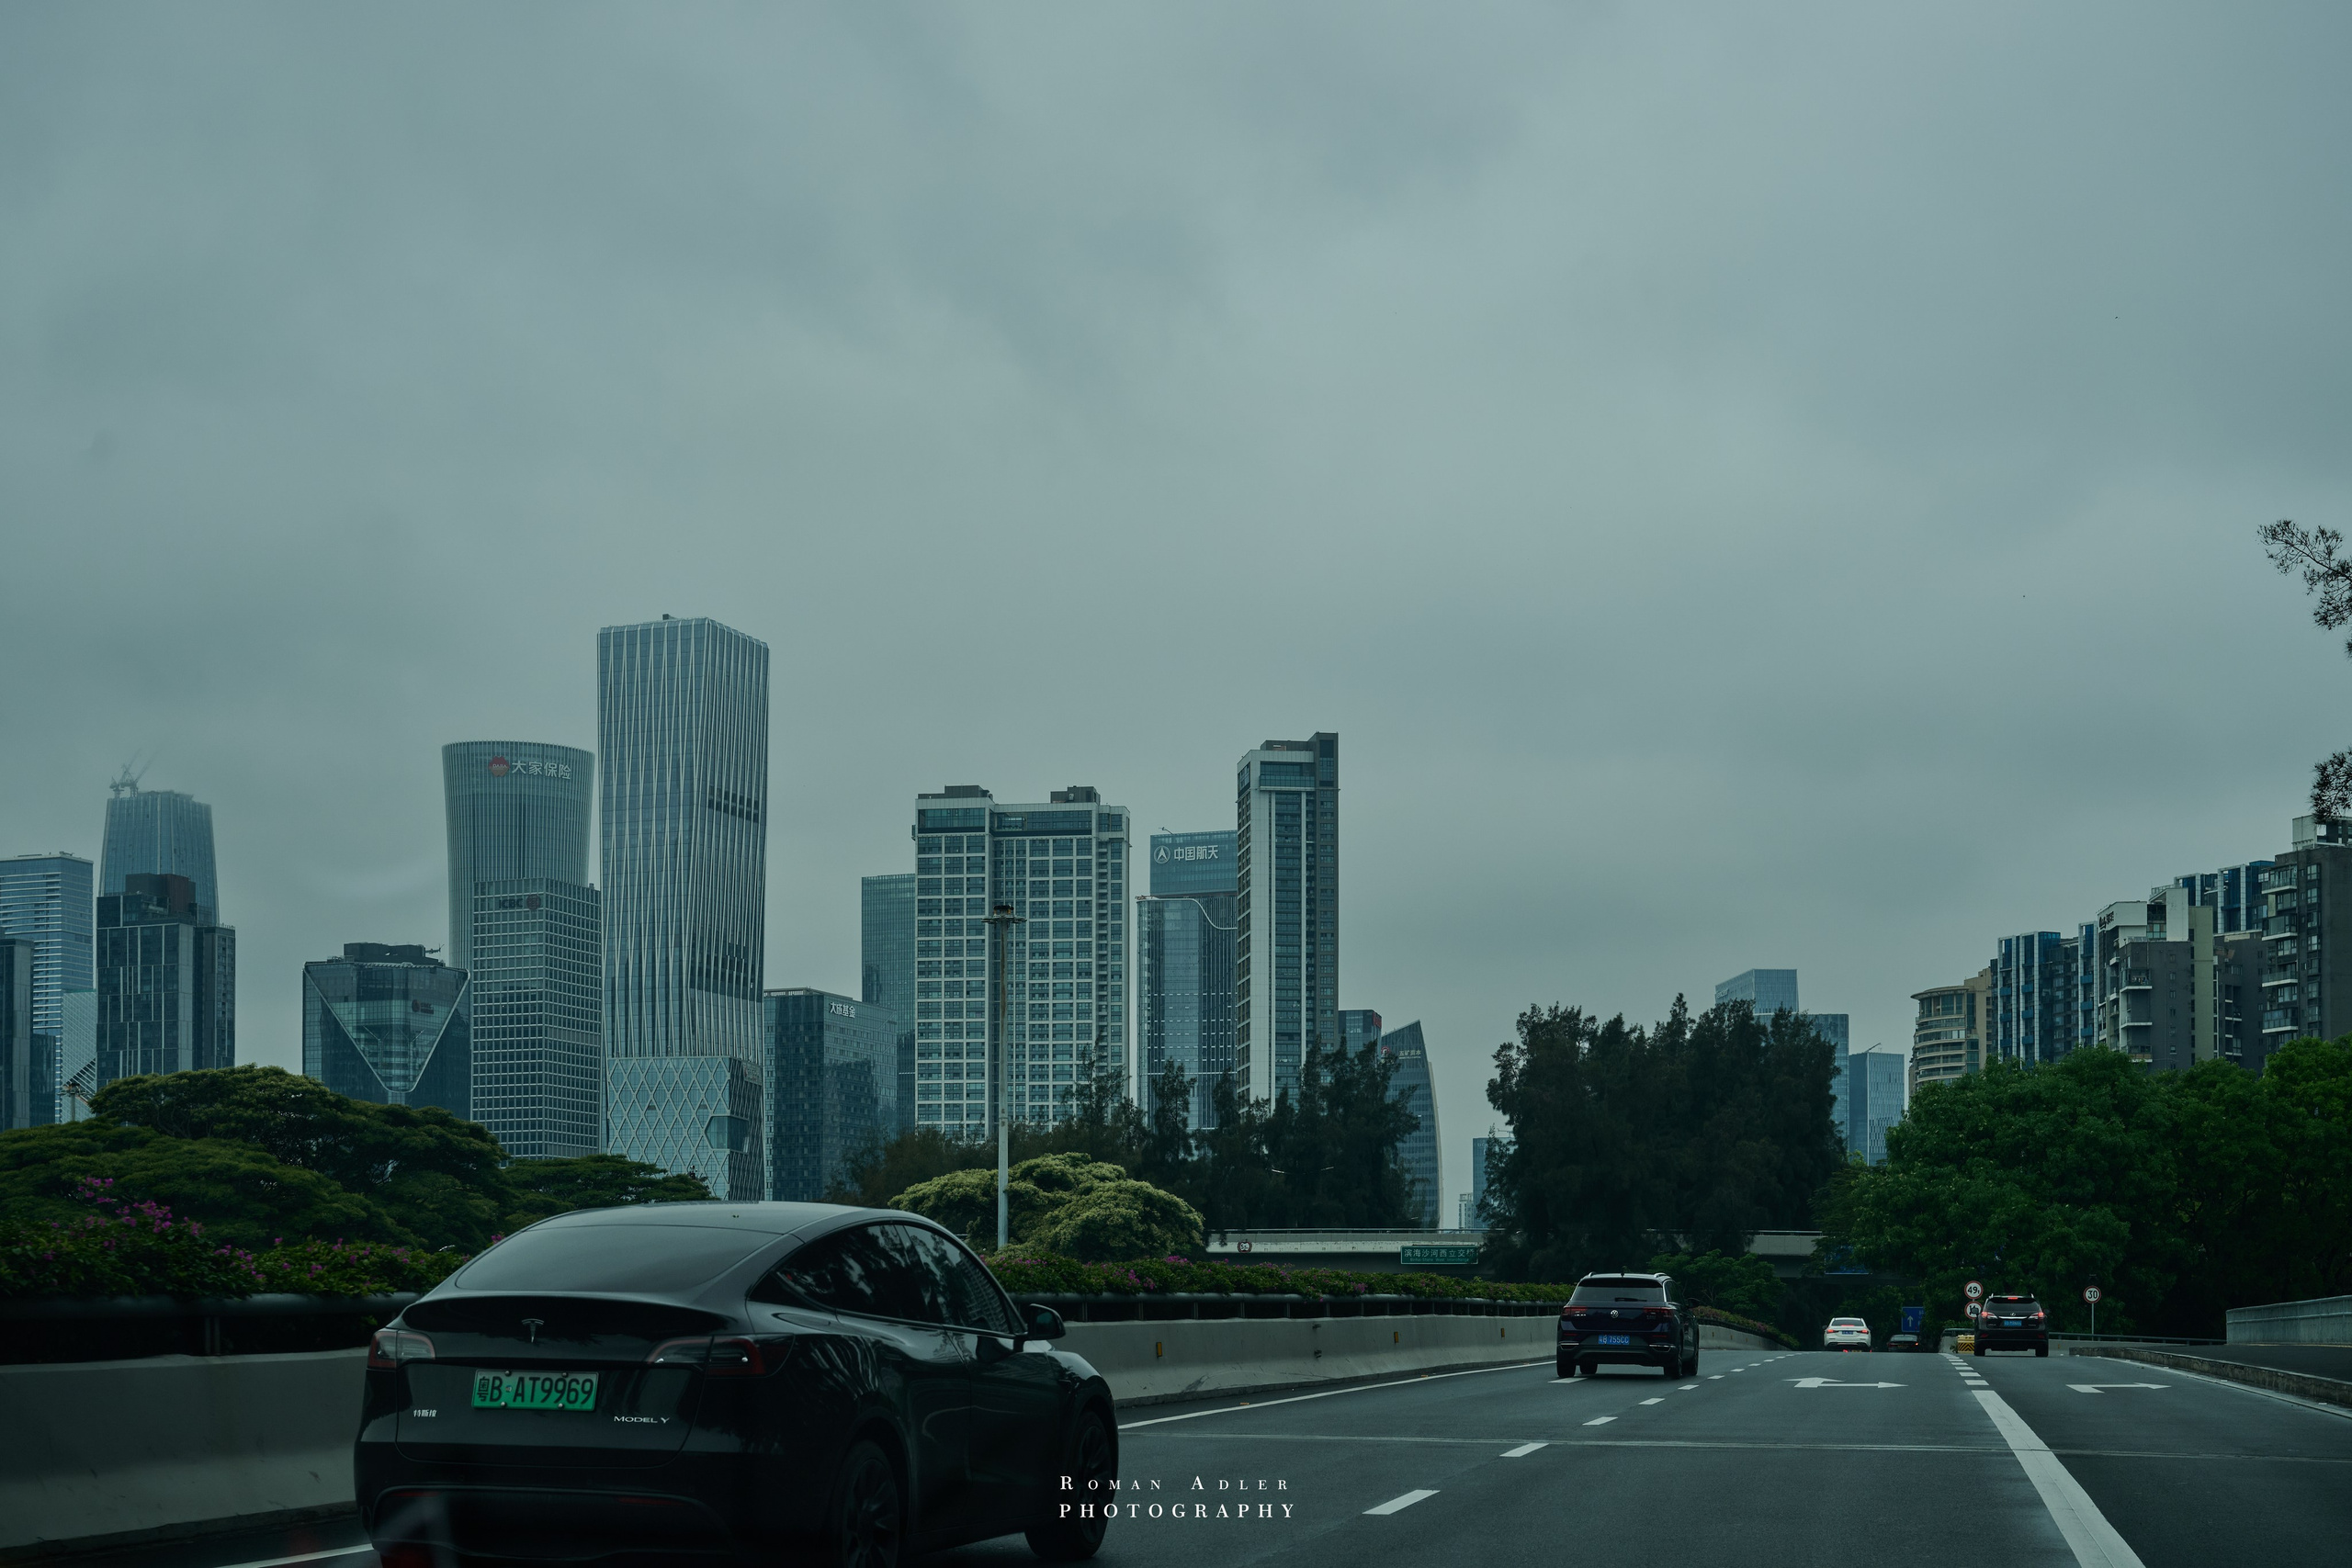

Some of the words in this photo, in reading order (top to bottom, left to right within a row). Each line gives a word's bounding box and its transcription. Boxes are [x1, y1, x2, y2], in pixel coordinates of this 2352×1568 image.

[512, 760, 571, 780] 大家保险
[1174, 845, 1218, 861] 中国航天
[499, 898, 524, 908] ICBC
[1404, 1248, 1475, 1258] 滨海沙河西立交桥
[2087, 1290, 2098, 1299] 30
